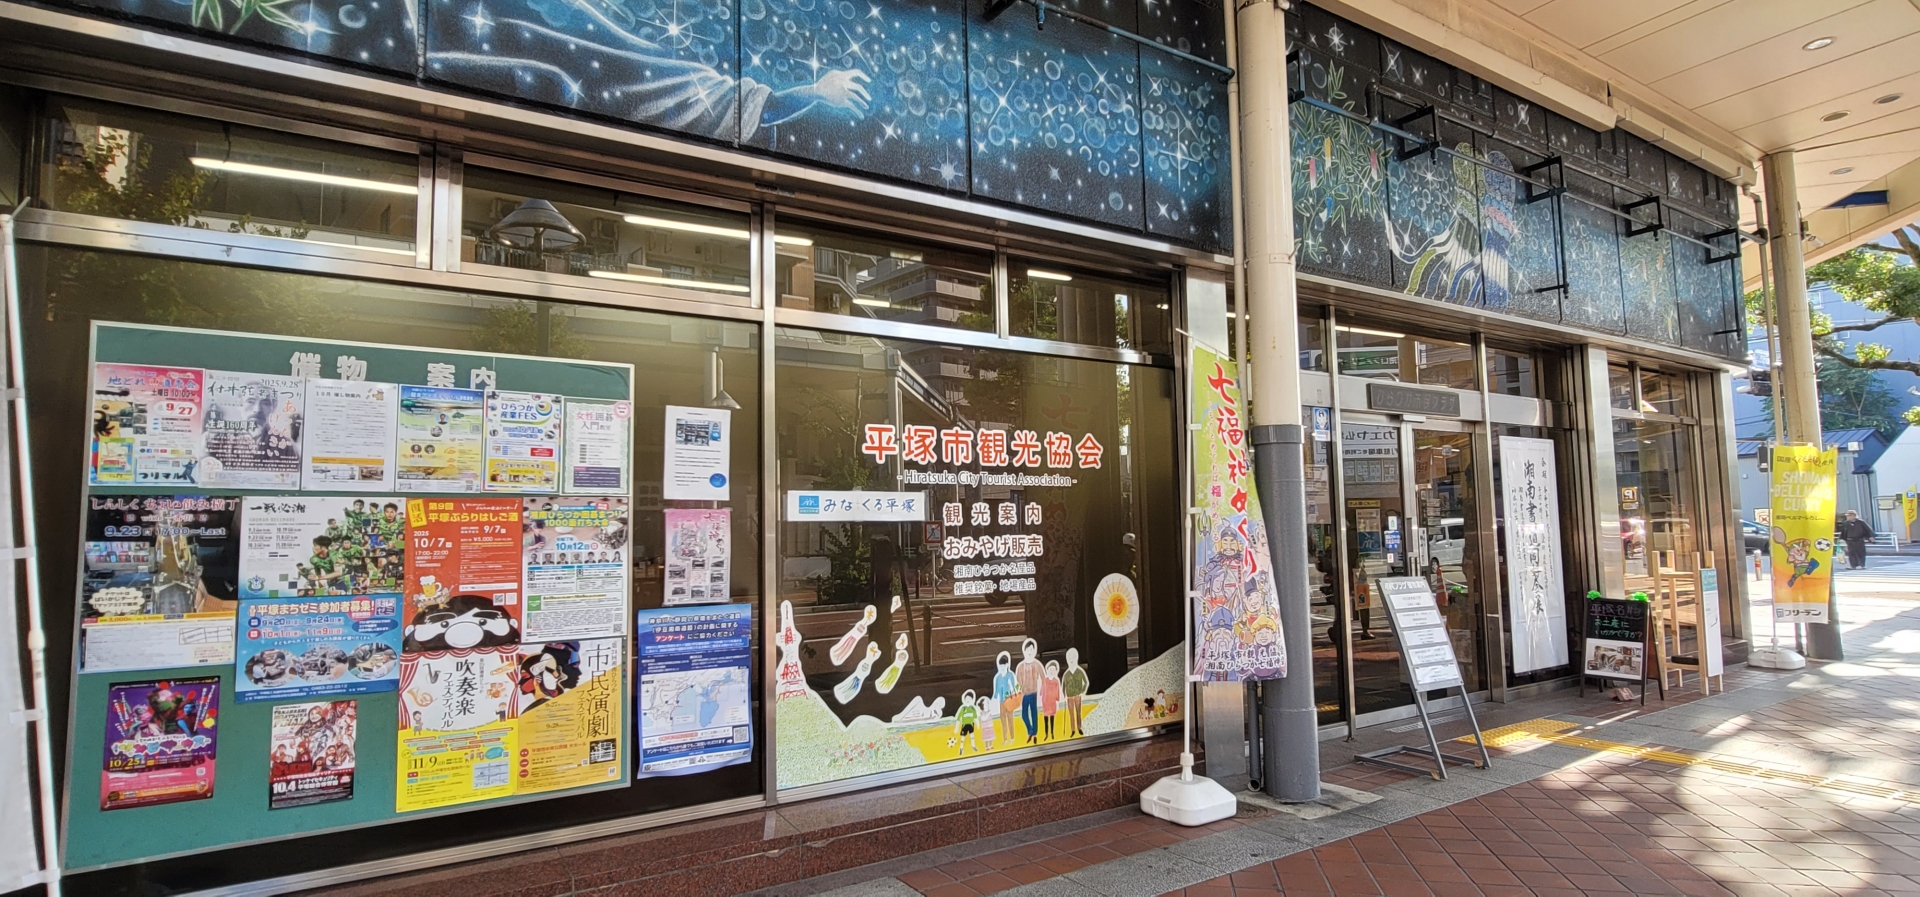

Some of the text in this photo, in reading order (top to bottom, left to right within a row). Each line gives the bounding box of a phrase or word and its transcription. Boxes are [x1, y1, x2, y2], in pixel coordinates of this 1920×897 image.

[427, 362, 496, 389] 案内
[260, 379, 299, 389] 2025.9.28
[166, 403, 193, 415] 9/27
[501, 403, 534, 412] ひらつか
[862, 423, 1103, 469] 平塚市観光協会
[905, 470, 1071, 487] Hiratsuka City Tourist Association
[1782, 471, 1830, 485] SHONAN
[1774, 484, 1833, 501] BELLMARE
[428, 512, 519, 522] 平塚ぶらりはしご酒
[530, 511, 622, 519] 湘南ひらつか囲碁まつり
[944, 503, 1042, 525] 観光案内
[105, 525, 141, 537] 9.23
[483, 525, 501, 533] 9/7
[414, 538, 445, 548] 10/7
[556, 542, 590, 551] 10月12日
[943, 537, 1043, 558] おみやげ販売
[954, 562, 1036, 578] 湘南ひらつか名産品
[1590, 603, 1642, 616] 平塚名物
[1594, 617, 1630, 628] お土産に
[655, 634, 685, 642] アンケート
[455, 659, 478, 717] 吹奏楽
[586, 643, 612, 738] 市民演劇
[441, 672, 454, 729] フェスティバル
[575, 690, 585, 740] フェスティバル
[413, 755, 437, 769] 11/9
[273, 781, 297, 794] 10.4
